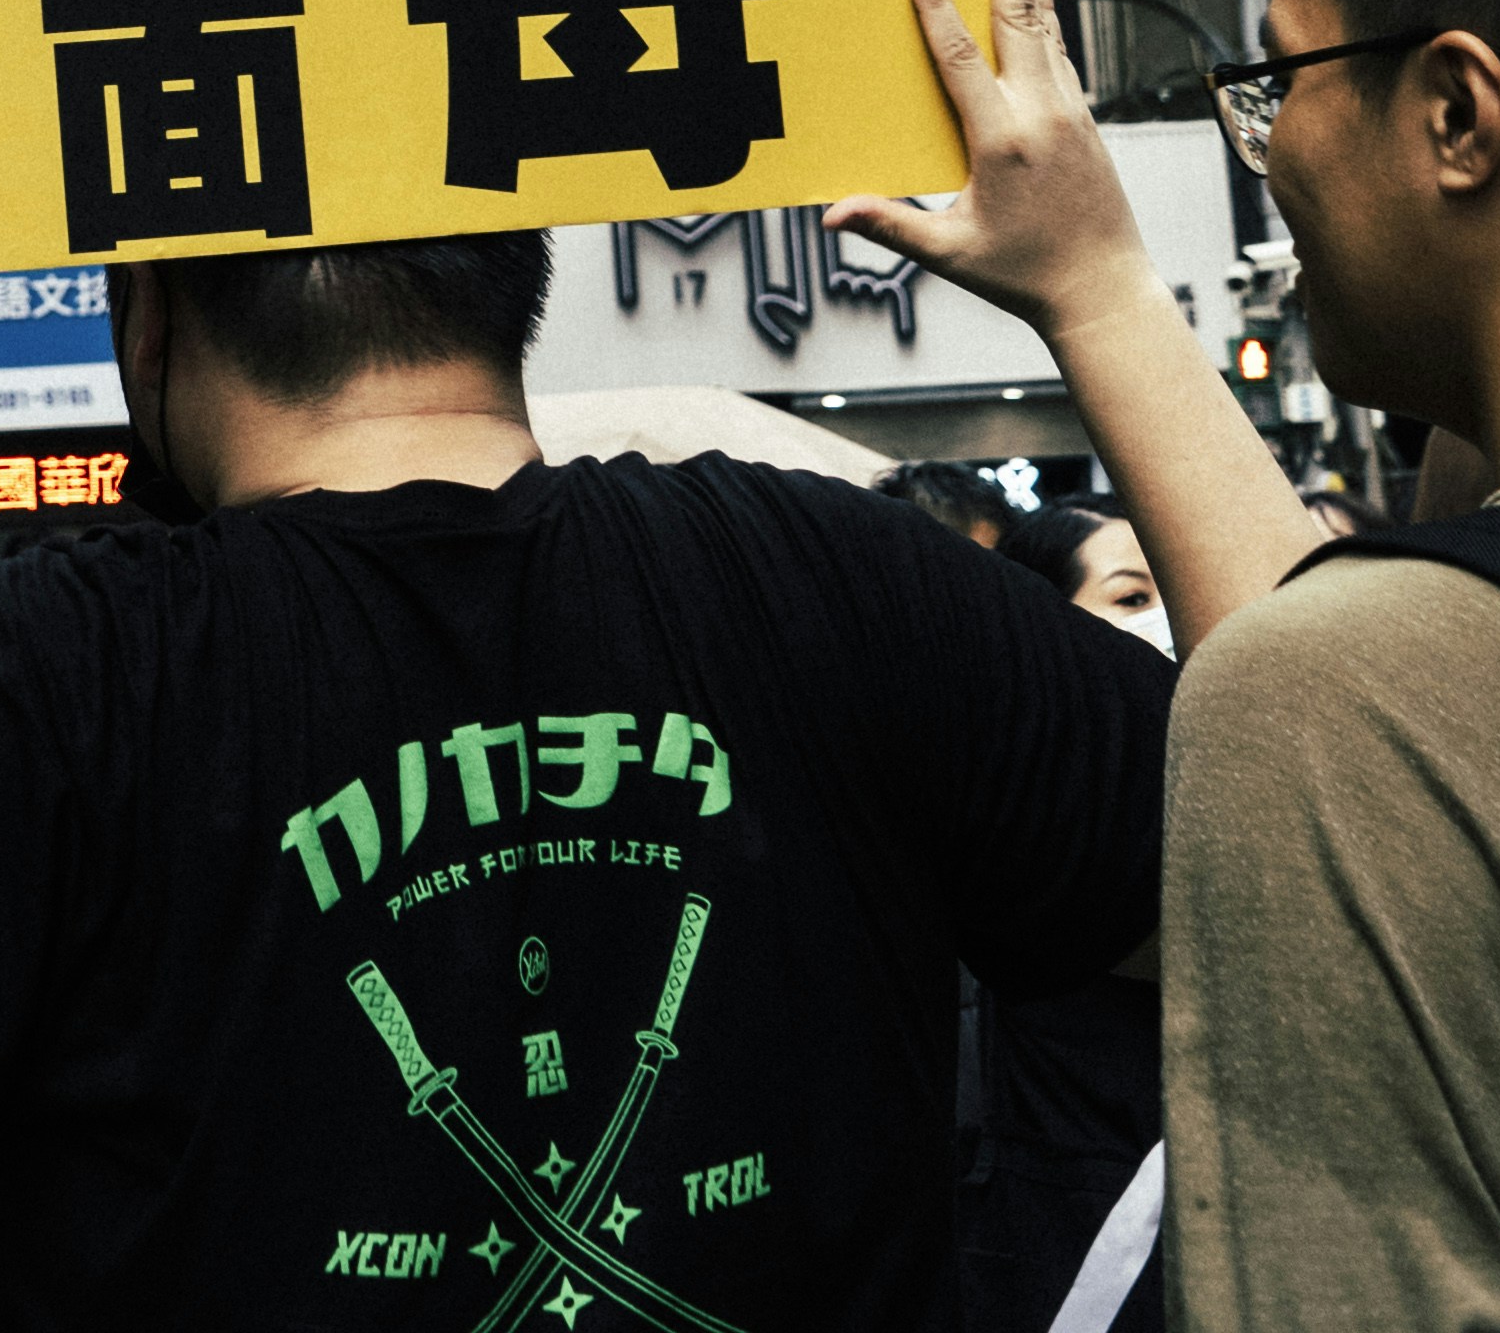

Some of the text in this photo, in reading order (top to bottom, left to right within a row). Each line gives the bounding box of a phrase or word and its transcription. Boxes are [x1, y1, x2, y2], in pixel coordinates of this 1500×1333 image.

[529, 837, 597, 867] OUR
[610, 839, 683, 871] LIFE
[522, 1030, 568, 1098] 忍
[683, 1152, 771, 1217] TROL
[325, 1231, 446, 1278] XCON
